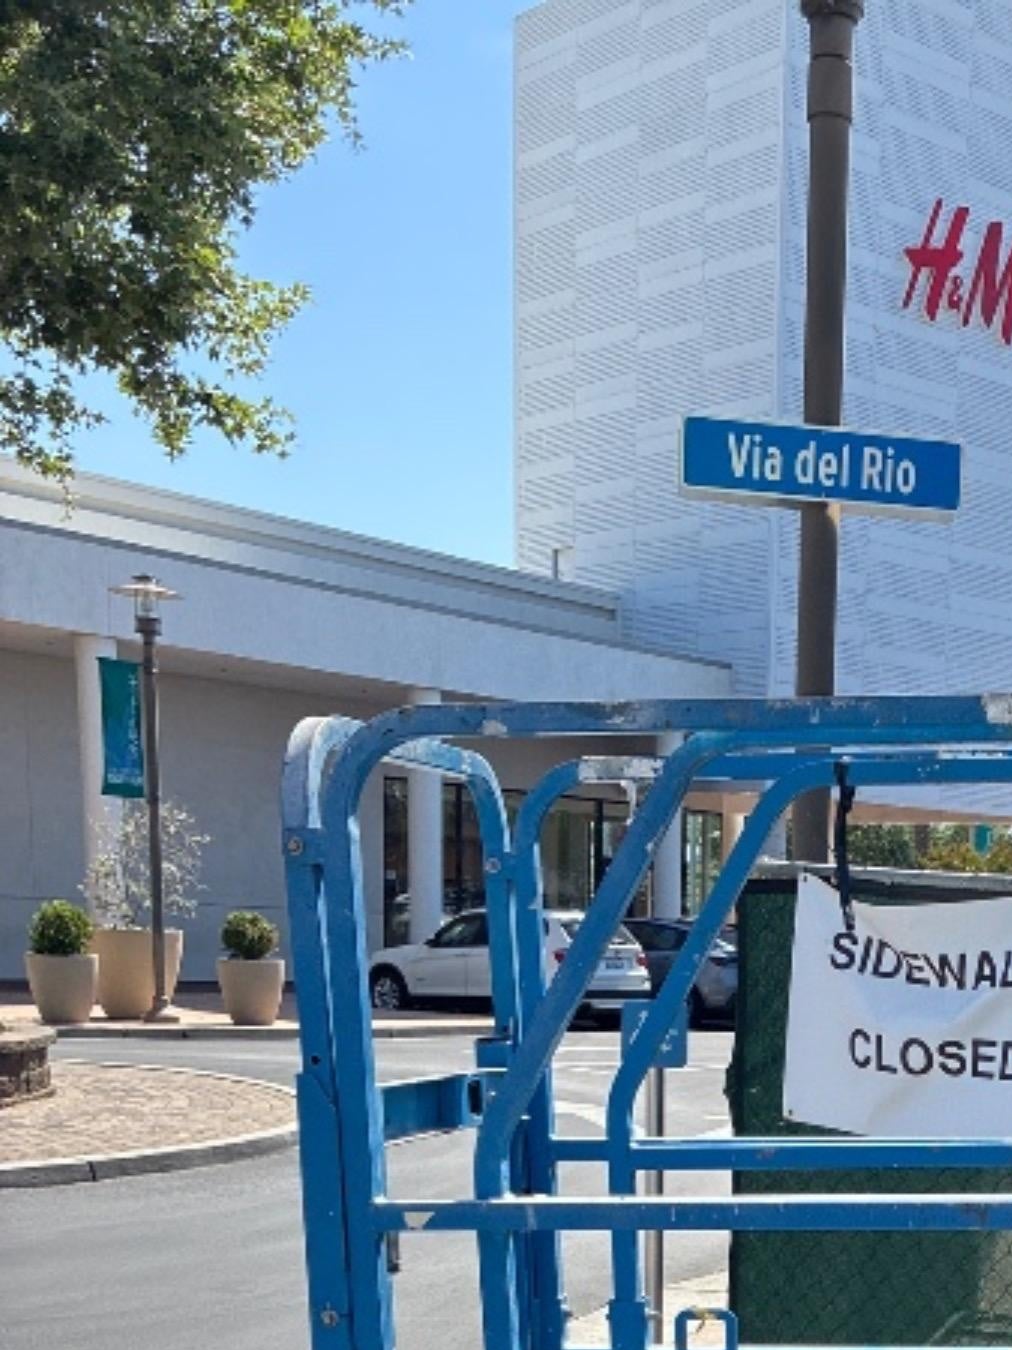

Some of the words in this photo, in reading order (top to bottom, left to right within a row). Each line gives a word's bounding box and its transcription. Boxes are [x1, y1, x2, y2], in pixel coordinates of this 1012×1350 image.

[728, 432, 783, 481] Via
[794, 440, 850, 489] del
[860, 446, 917, 494] Rio
